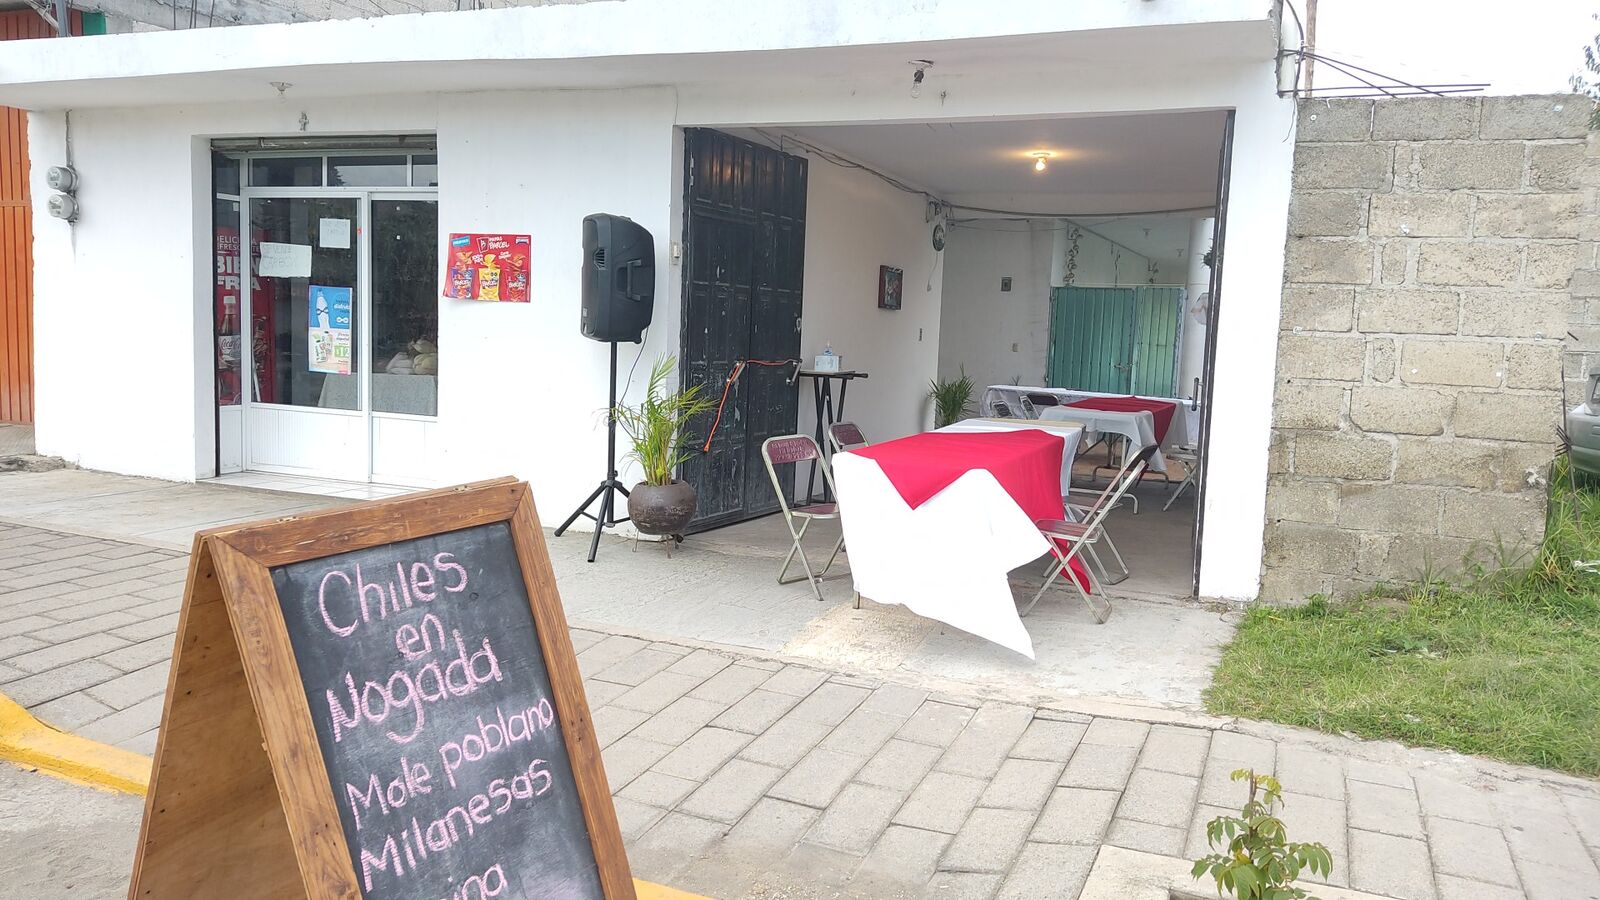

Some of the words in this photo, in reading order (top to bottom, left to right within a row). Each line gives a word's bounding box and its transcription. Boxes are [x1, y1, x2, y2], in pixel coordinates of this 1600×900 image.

[318, 552, 469, 637] Chiles
[396, 612, 447, 660] en
[326, 628, 504, 746] Nogada
[344, 755, 433, 830] Mole
[439, 697, 555, 790] poblano
[359, 758, 553, 894] Milanesas
